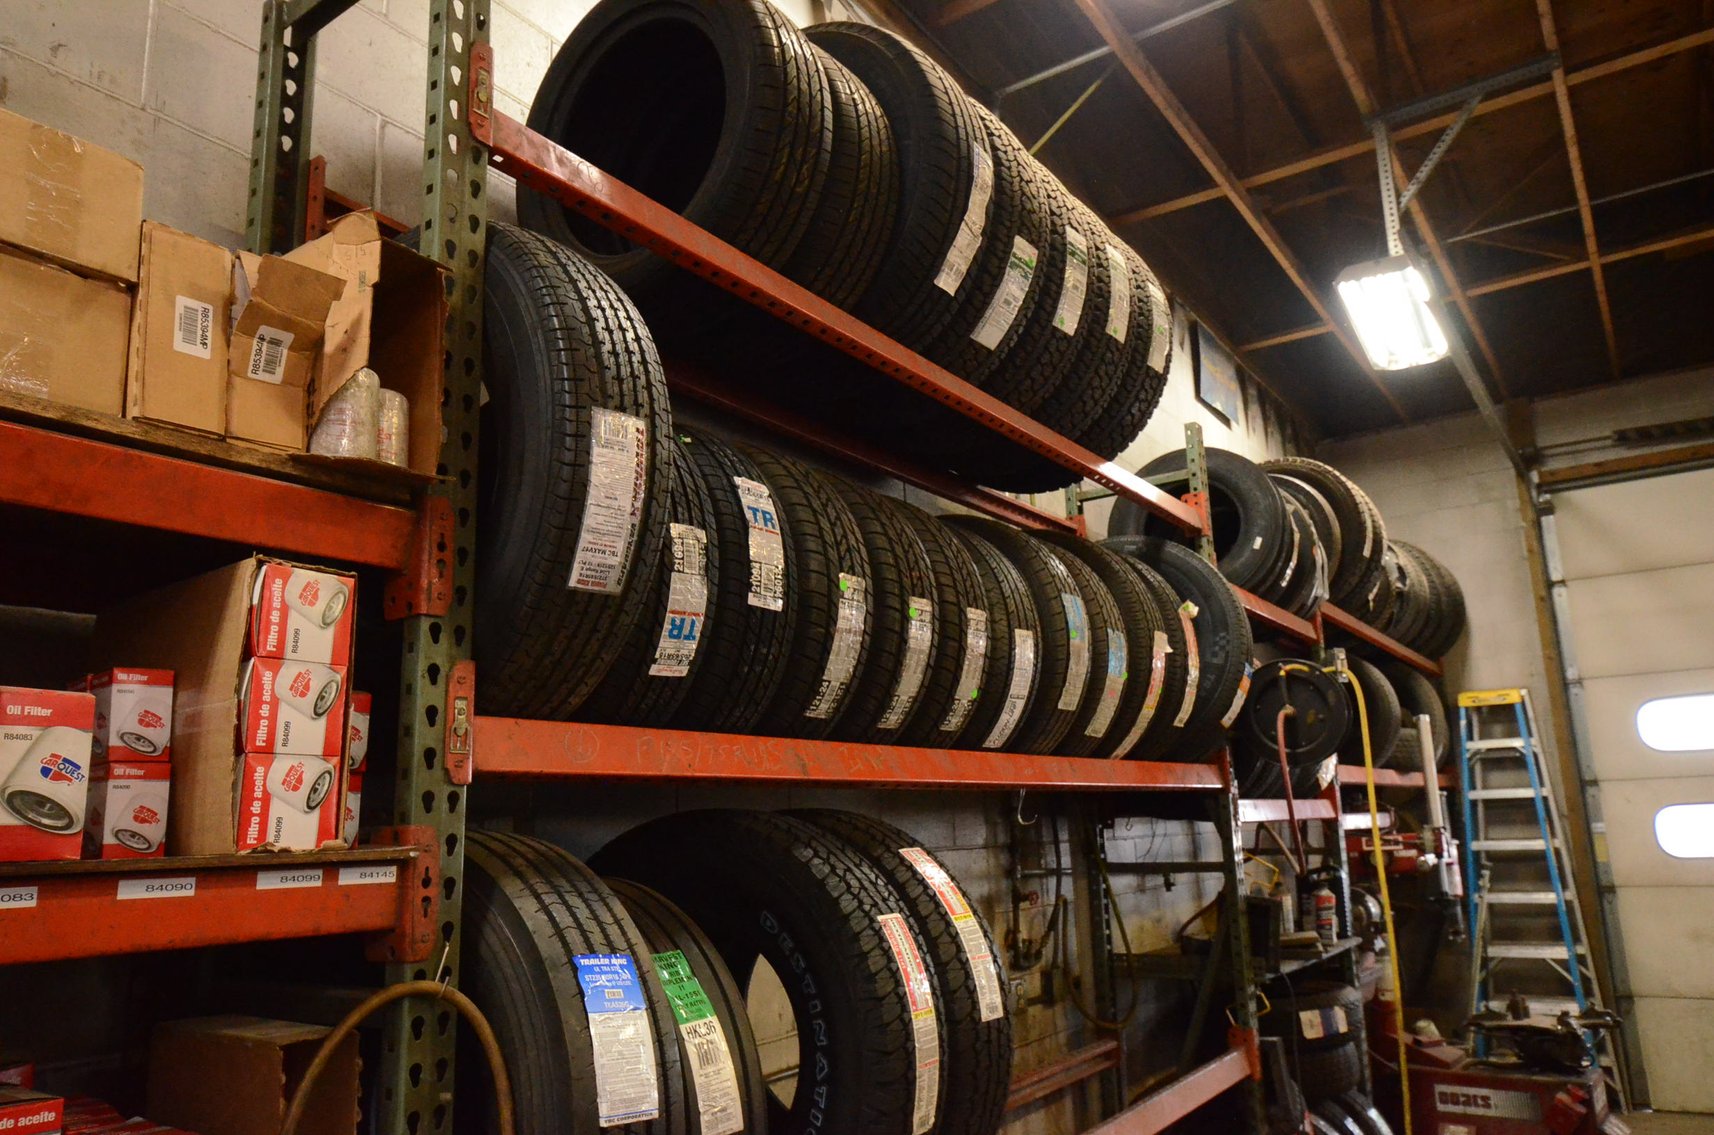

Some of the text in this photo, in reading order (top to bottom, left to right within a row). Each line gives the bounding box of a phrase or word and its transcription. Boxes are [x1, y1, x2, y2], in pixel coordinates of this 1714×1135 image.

[747, 505, 777, 530] TR
[751, 562, 763, 594] 21094
[272, 609, 280, 623] de
[267, 624, 280, 652] Filtro
[668, 616, 699, 640] TR
[292, 628, 300, 654] R84099
[128, 674, 148, 682] Filter
[6, 704, 53, 717] Oil Filter
[256, 671, 272, 746] Filtro de aceite
[4, 732, 33, 742] R84083
[282, 721, 292, 748] R84099
[40, 756, 86, 783] CARQUEST
[114, 768, 145, 776] Oil Filter
[246, 766, 265, 844] Filtro de aceite
[273, 816, 284, 844] R84099
[280, 873, 321, 884] 84099
[358, 870, 396, 880] 84145
[145, 882, 194, 894] 84090
[580, 958, 610, 966] TRAILER
[0, 1111, 56, 1130] de aceite
